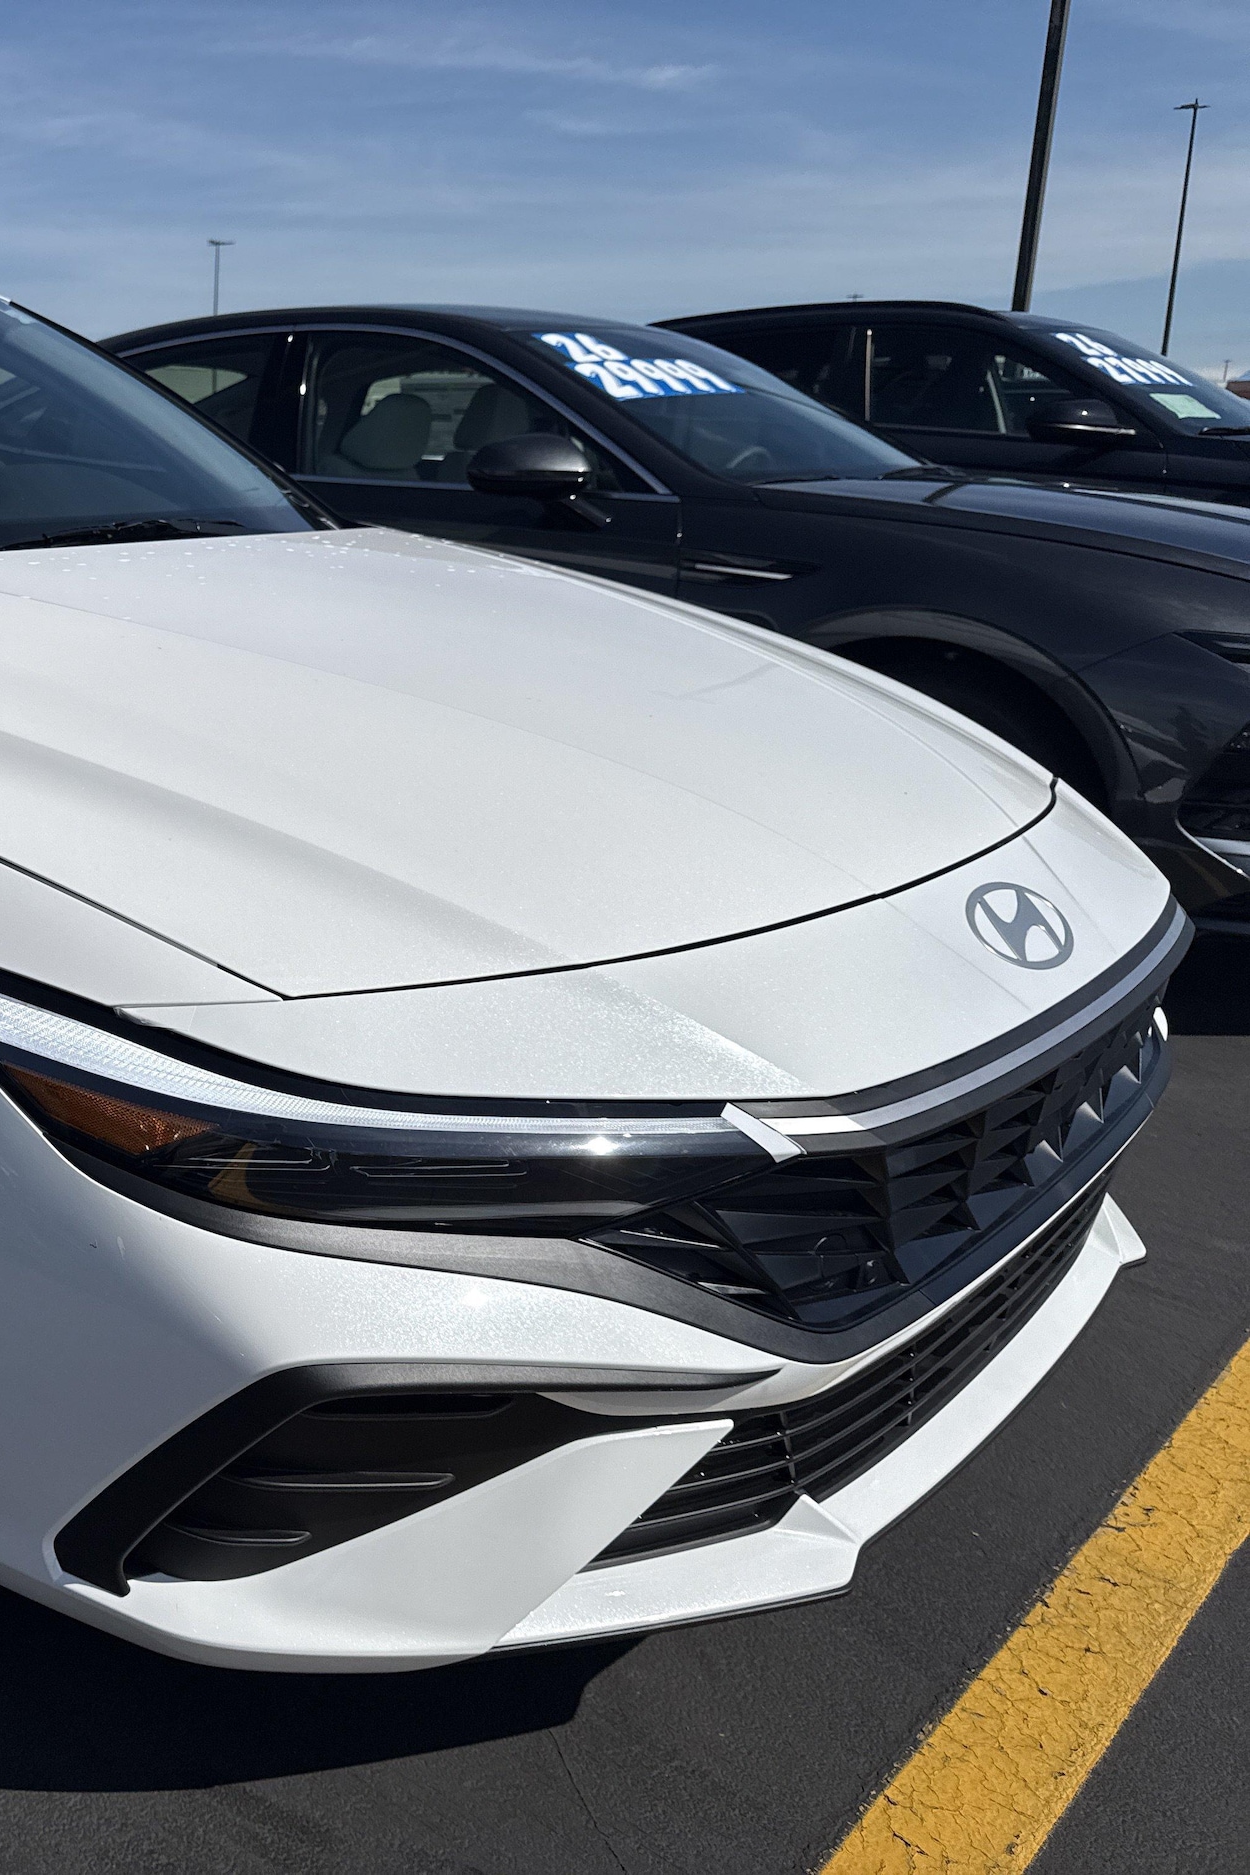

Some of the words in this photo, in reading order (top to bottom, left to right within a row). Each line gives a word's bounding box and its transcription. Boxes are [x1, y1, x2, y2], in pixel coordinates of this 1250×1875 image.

[541, 333, 629, 362] 26
[1055, 333, 1118, 356] 26
[574, 359, 737, 398] 29999
